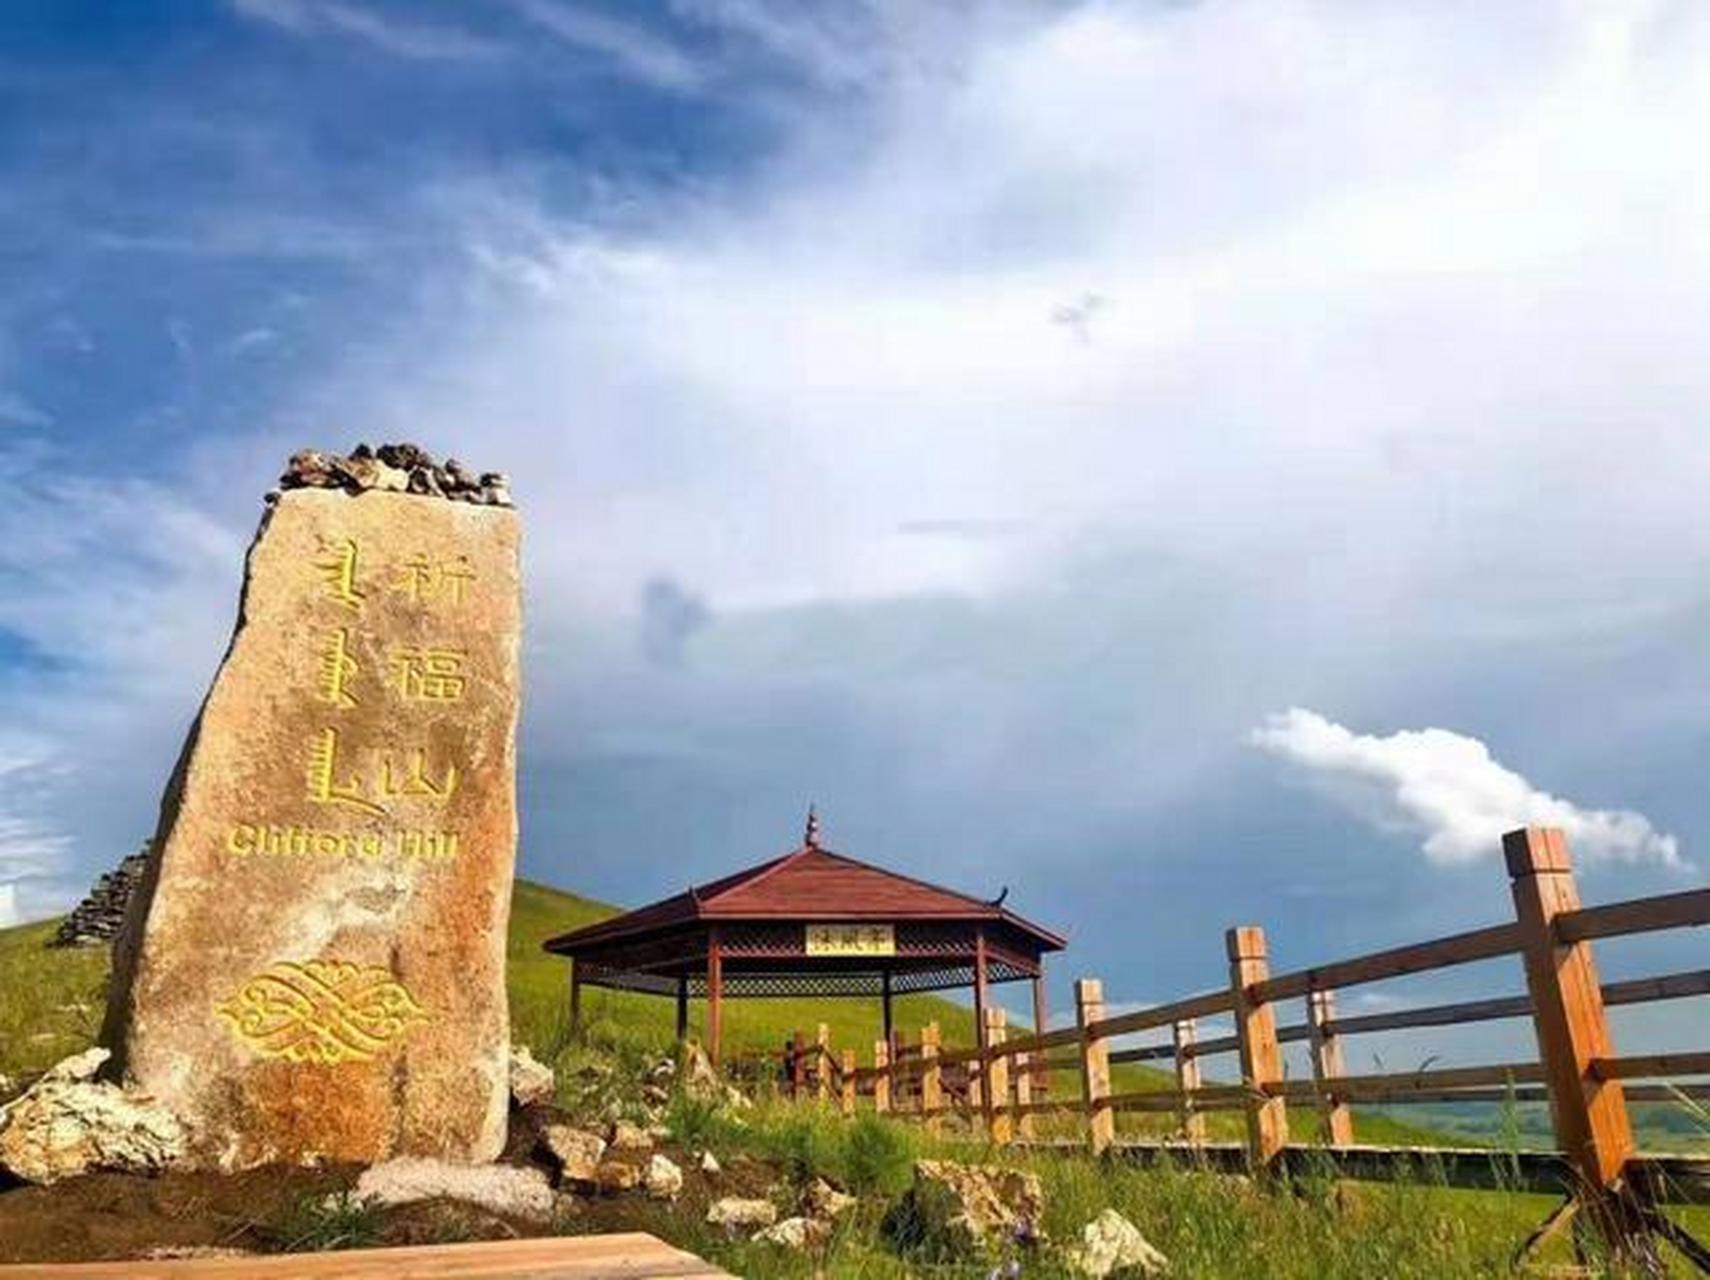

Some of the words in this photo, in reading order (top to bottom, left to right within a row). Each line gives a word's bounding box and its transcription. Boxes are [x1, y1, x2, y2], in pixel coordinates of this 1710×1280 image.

[379, 552, 476, 801] 祈福山
[398, 830, 459, 857] Hill
